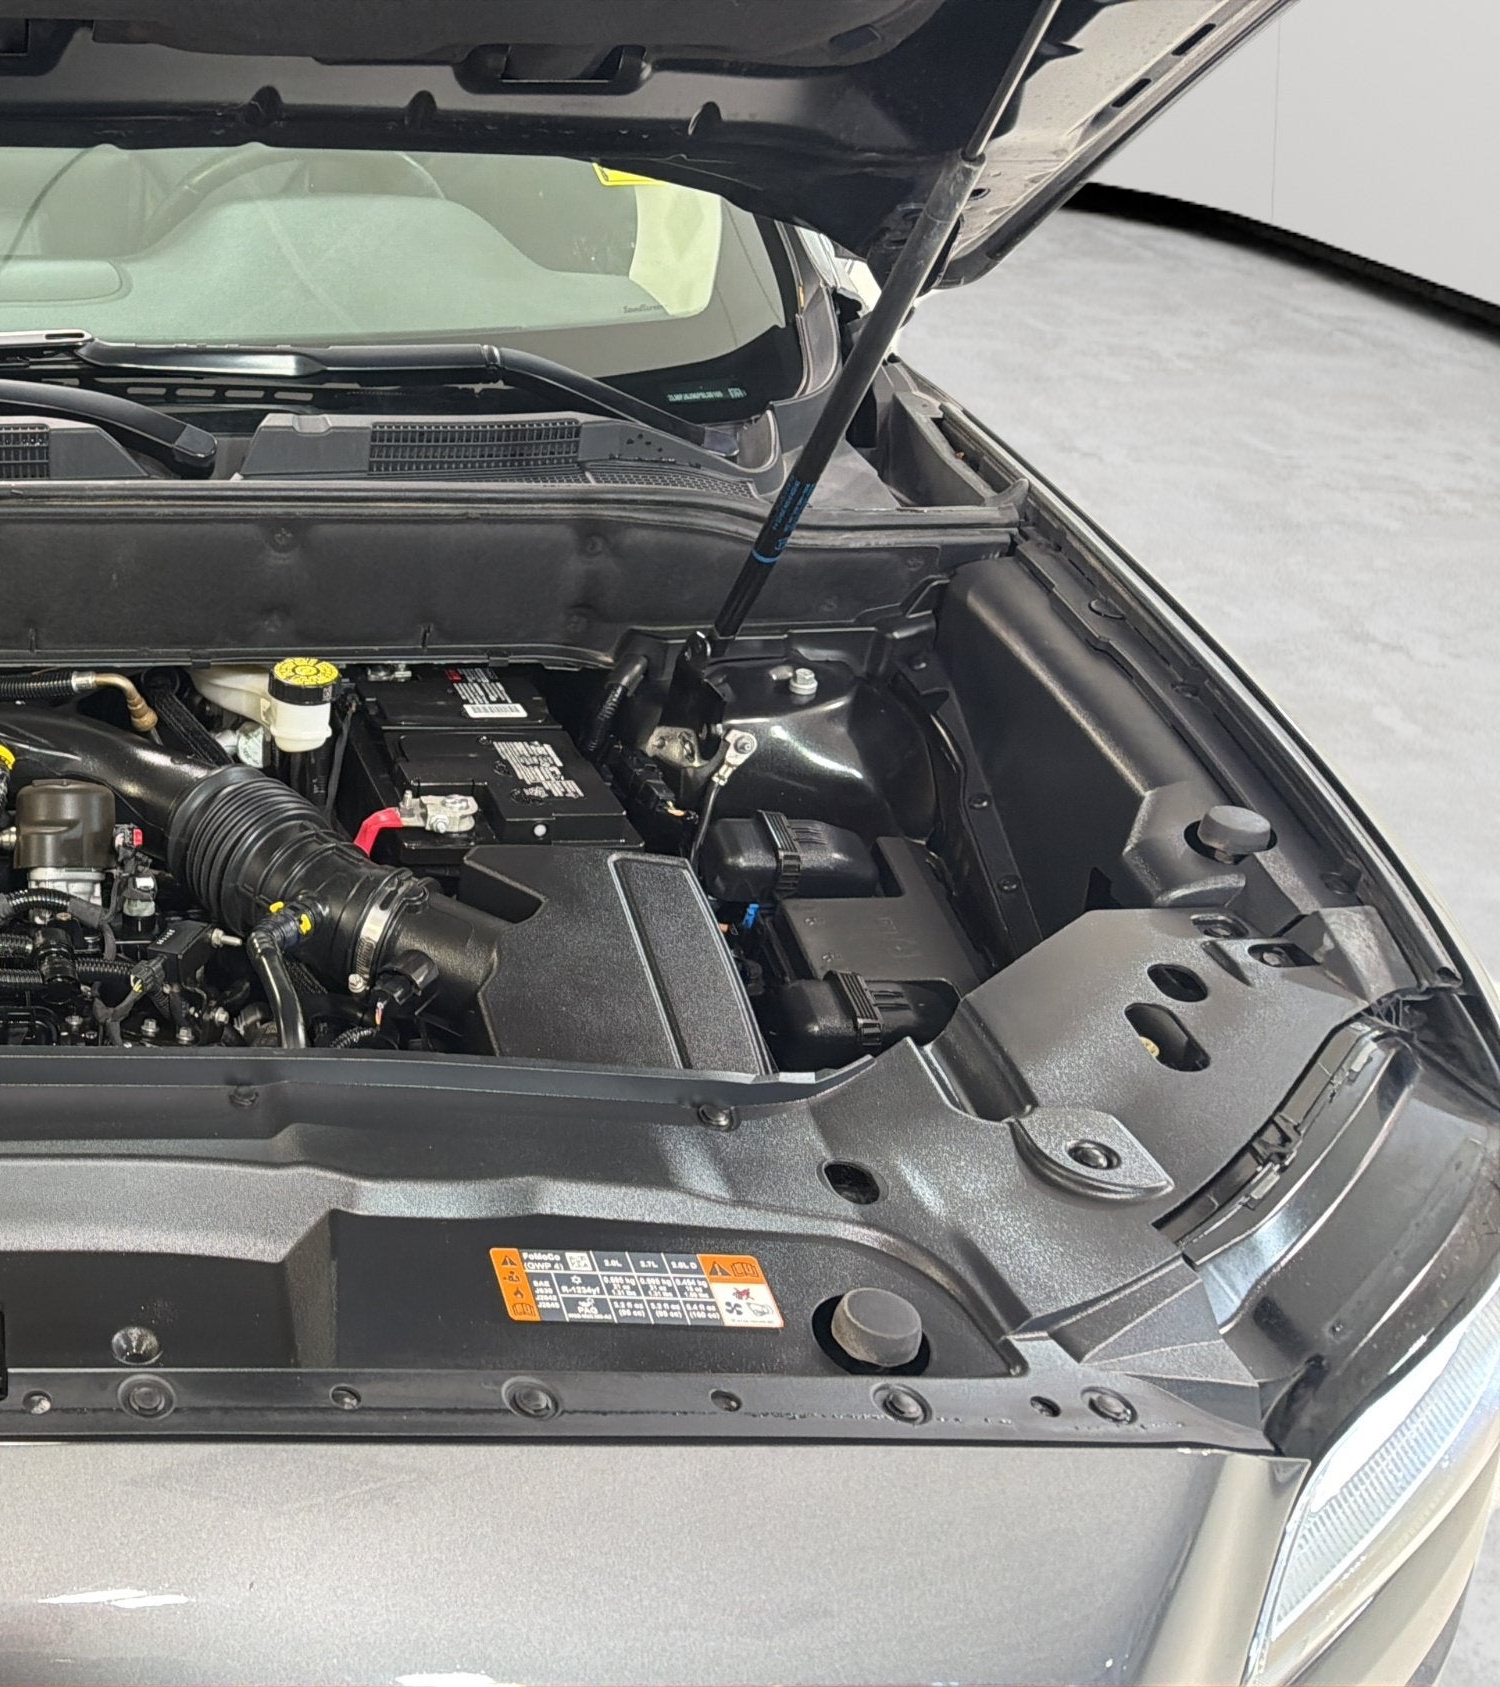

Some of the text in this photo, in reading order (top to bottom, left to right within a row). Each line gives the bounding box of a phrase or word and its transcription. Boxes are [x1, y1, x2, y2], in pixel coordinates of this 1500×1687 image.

[522, 1252, 561, 1261] FoMoCo
[561, 1286, 601, 1295] R-1234yf
[577, 1306, 599, 1315] PAG
